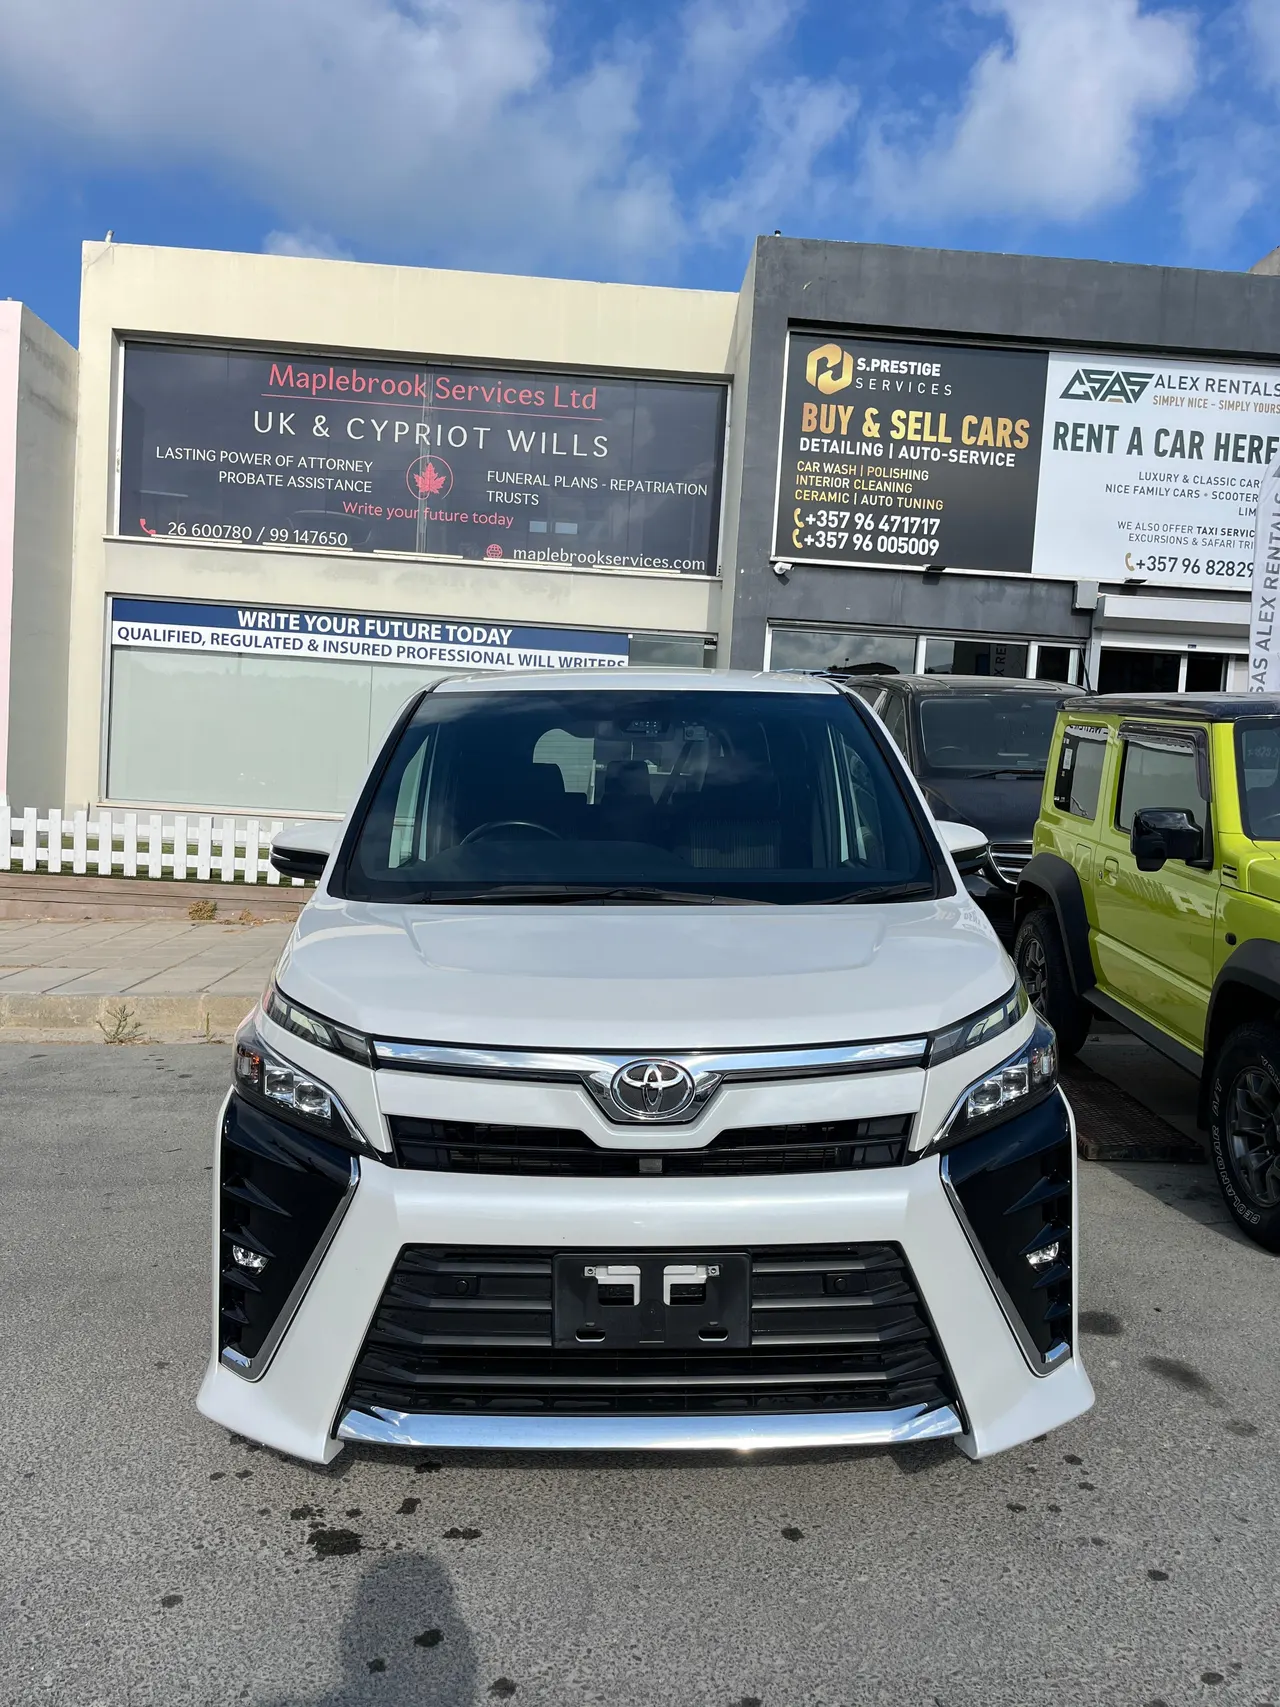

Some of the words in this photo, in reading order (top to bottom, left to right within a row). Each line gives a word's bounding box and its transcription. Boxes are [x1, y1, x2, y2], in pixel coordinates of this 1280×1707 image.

[857, 358, 941, 376] S.PRESTIGE
[269, 364, 426, 398] Maplebrook
[436, 377, 544, 406] Services
[554, 386, 597, 410] Ltd
[856, 378, 952, 396] SERVICES
[1154, 374, 1200, 392] ALEX
[1205, 378, 1280, 398] RENTALS
[1153, 396, 1185, 408] SIMPLY
[1188, 398, 1208, 408] NICE
[1218, 400, 1250, 412] SIMPLY
[1254, 402, 1280, 414] YOURS
[254, 410, 296, 434] UK
[313, 415, 330, 438] &
[347, 418, 490, 450] CYPRIOT
[508, 430, 608, 458] WILLS
[802, 402, 854, 435] BUY
[862, 408, 881, 438] &
[890, 410, 952, 444] SELL
[961, 415, 1030, 449] CARS
[1052, 421, 1120, 454] RENT
[1126, 426, 1144, 456] A
[1154, 428, 1204, 460] CAR
[156, 446, 216, 462] LASTING
[220, 450, 271, 466] POWER
[276, 454, 294, 467] OF
[298, 456, 373, 472] ATTORNEY
[800, 438, 884, 457] DETAILING
[898, 446, 1016, 468] AUTO-SERVICE
[219, 471, 282, 487] PROBATE
[287, 476, 372, 492] ASSISTANCE
[488, 470, 550, 486] FUNERAL
[554, 476, 598, 489] PLANS
[610, 480, 708, 496] REPATRIATION
[797, 461, 820, 473] CAR
[823, 463, 857, 476] WASH
[867, 467, 929, 481] POLISHING
[1139, 472, 1179, 484] LUXURY
[1182, 474, 1190, 484] &
[1193, 476, 1236, 488] CLASSIC
[1240, 479, 1262, 488] CAR
[796, 475, 850, 489] INTERIOR
[854, 479, 912, 494] CLEANING
[1105, 484, 1130, 494] NICE
[1133, 486, 1170, 497] FAMILY
[1173, 488, 1200, 499] CARS
[486, 490, 539, 505] TRUSTS
[795, 490, 850, 504] CERAMIC
[861, 494, 892, 506] AUTO
[897, 496, 944, 510] TUNING
[343, 502, 382, 516] Write
[386, 507, 420, 520] your
[424, 508, 468, 522] future
[472, 512, 514, 528] today
[806, 510, 850, 529] +357
[854, 513, 874, 530] 96
[878, 514, 940, 536] 471717
[168, 522, 186, 536] 26
[192, 524, 252, 540] 600780
[270, 528, 288, 542] 99
[294, 530, 348, 546] 147650
[1118, 521, 1132, 530] WE
[1135, 522, 1160, 532] ALSO
[1162, 524, 1193, 534] OFFER
[1196, 526, 1218, 536] TAXI
[1128, 533, 1188, 546] EXCURSIONS
[1192, 537, 1198, 546] &
[1202, 538, 1235, 548] SAFARI
[804, 531, 849, 550] +357
[852, 534, 873, 552] 96
[877, 536, 940, 556] 005009
[514, 547, 704, 570] maplebrookservices.com
[1136, 556, 1178, 572] +357
[1182, 558, 1200, 574] 96
[238, 610, 300, 630] WRITE
[304, 614, 360, 634] YOUR
[365, 620, 442, 641] FUTURE
[446, 625, 512, 646] TODAY
[1255, 596, 1276, 652] ALEX
[118, 626, 206, 646] QUALIFIED,
[211, 633, 303, 650] REGULATED
[308, 639, 319, 652] &
[323, 641, 392, 658] INSURED
[397, 646, 514, 666] PROFESSIONAL
[518, 654, 554, 668] WILL
